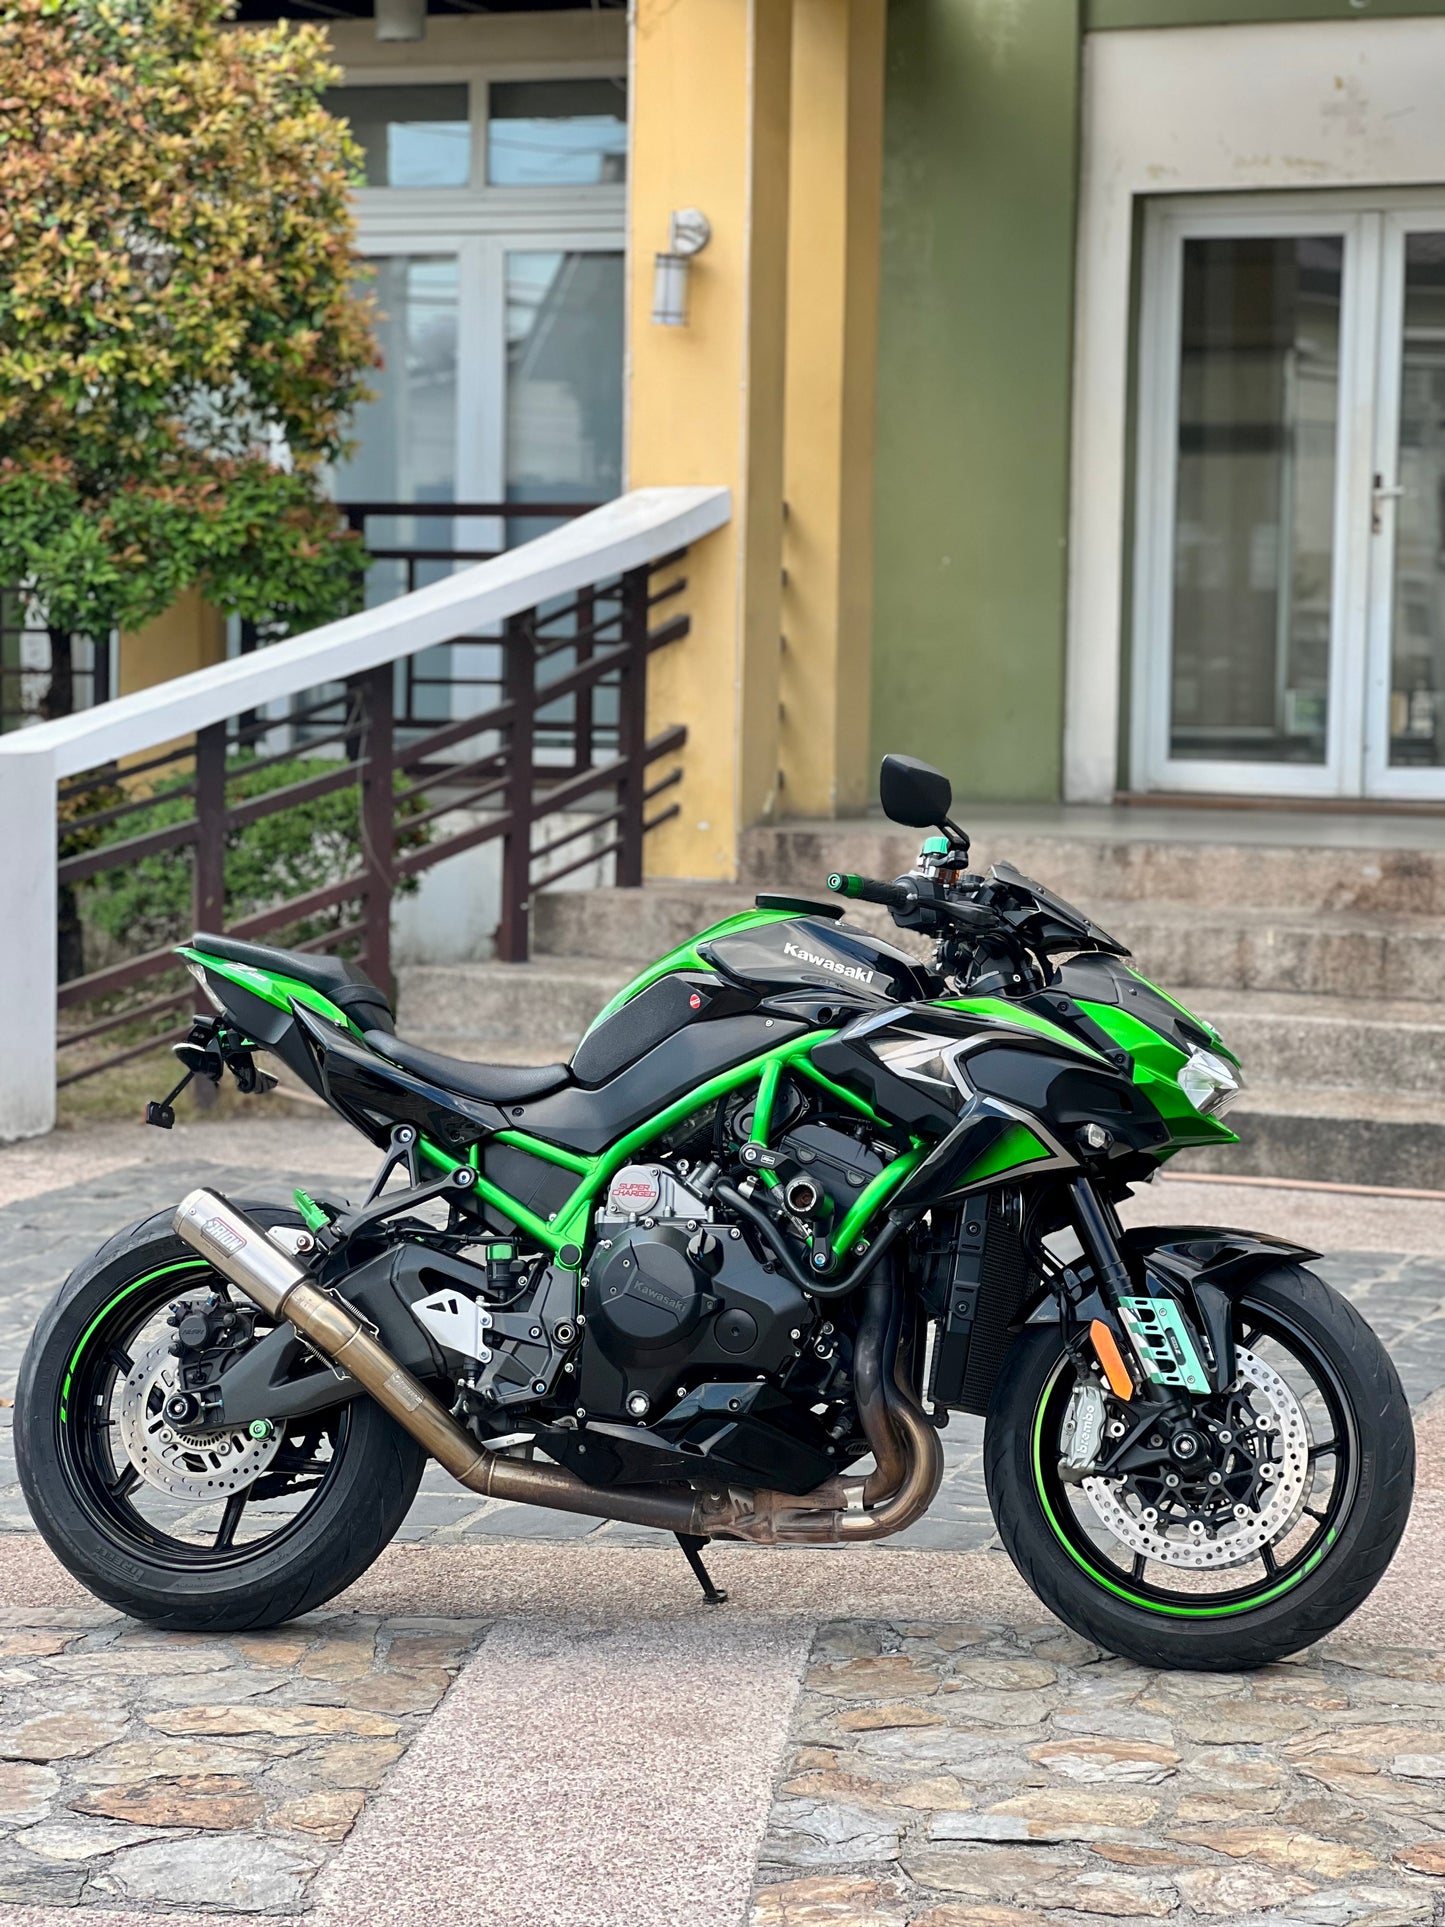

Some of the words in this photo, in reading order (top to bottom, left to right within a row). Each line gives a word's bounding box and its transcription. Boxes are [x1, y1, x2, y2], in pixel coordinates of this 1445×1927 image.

[783, 942, 874, 984] Kawasaki
[612, 1190, 656, 1198] CHARGED
[618, 1183, 651, 1191] SUPER
[633, 1280, 686, 1313] Kawasaki
[1076, 1404, 1095, 1454] brembo
